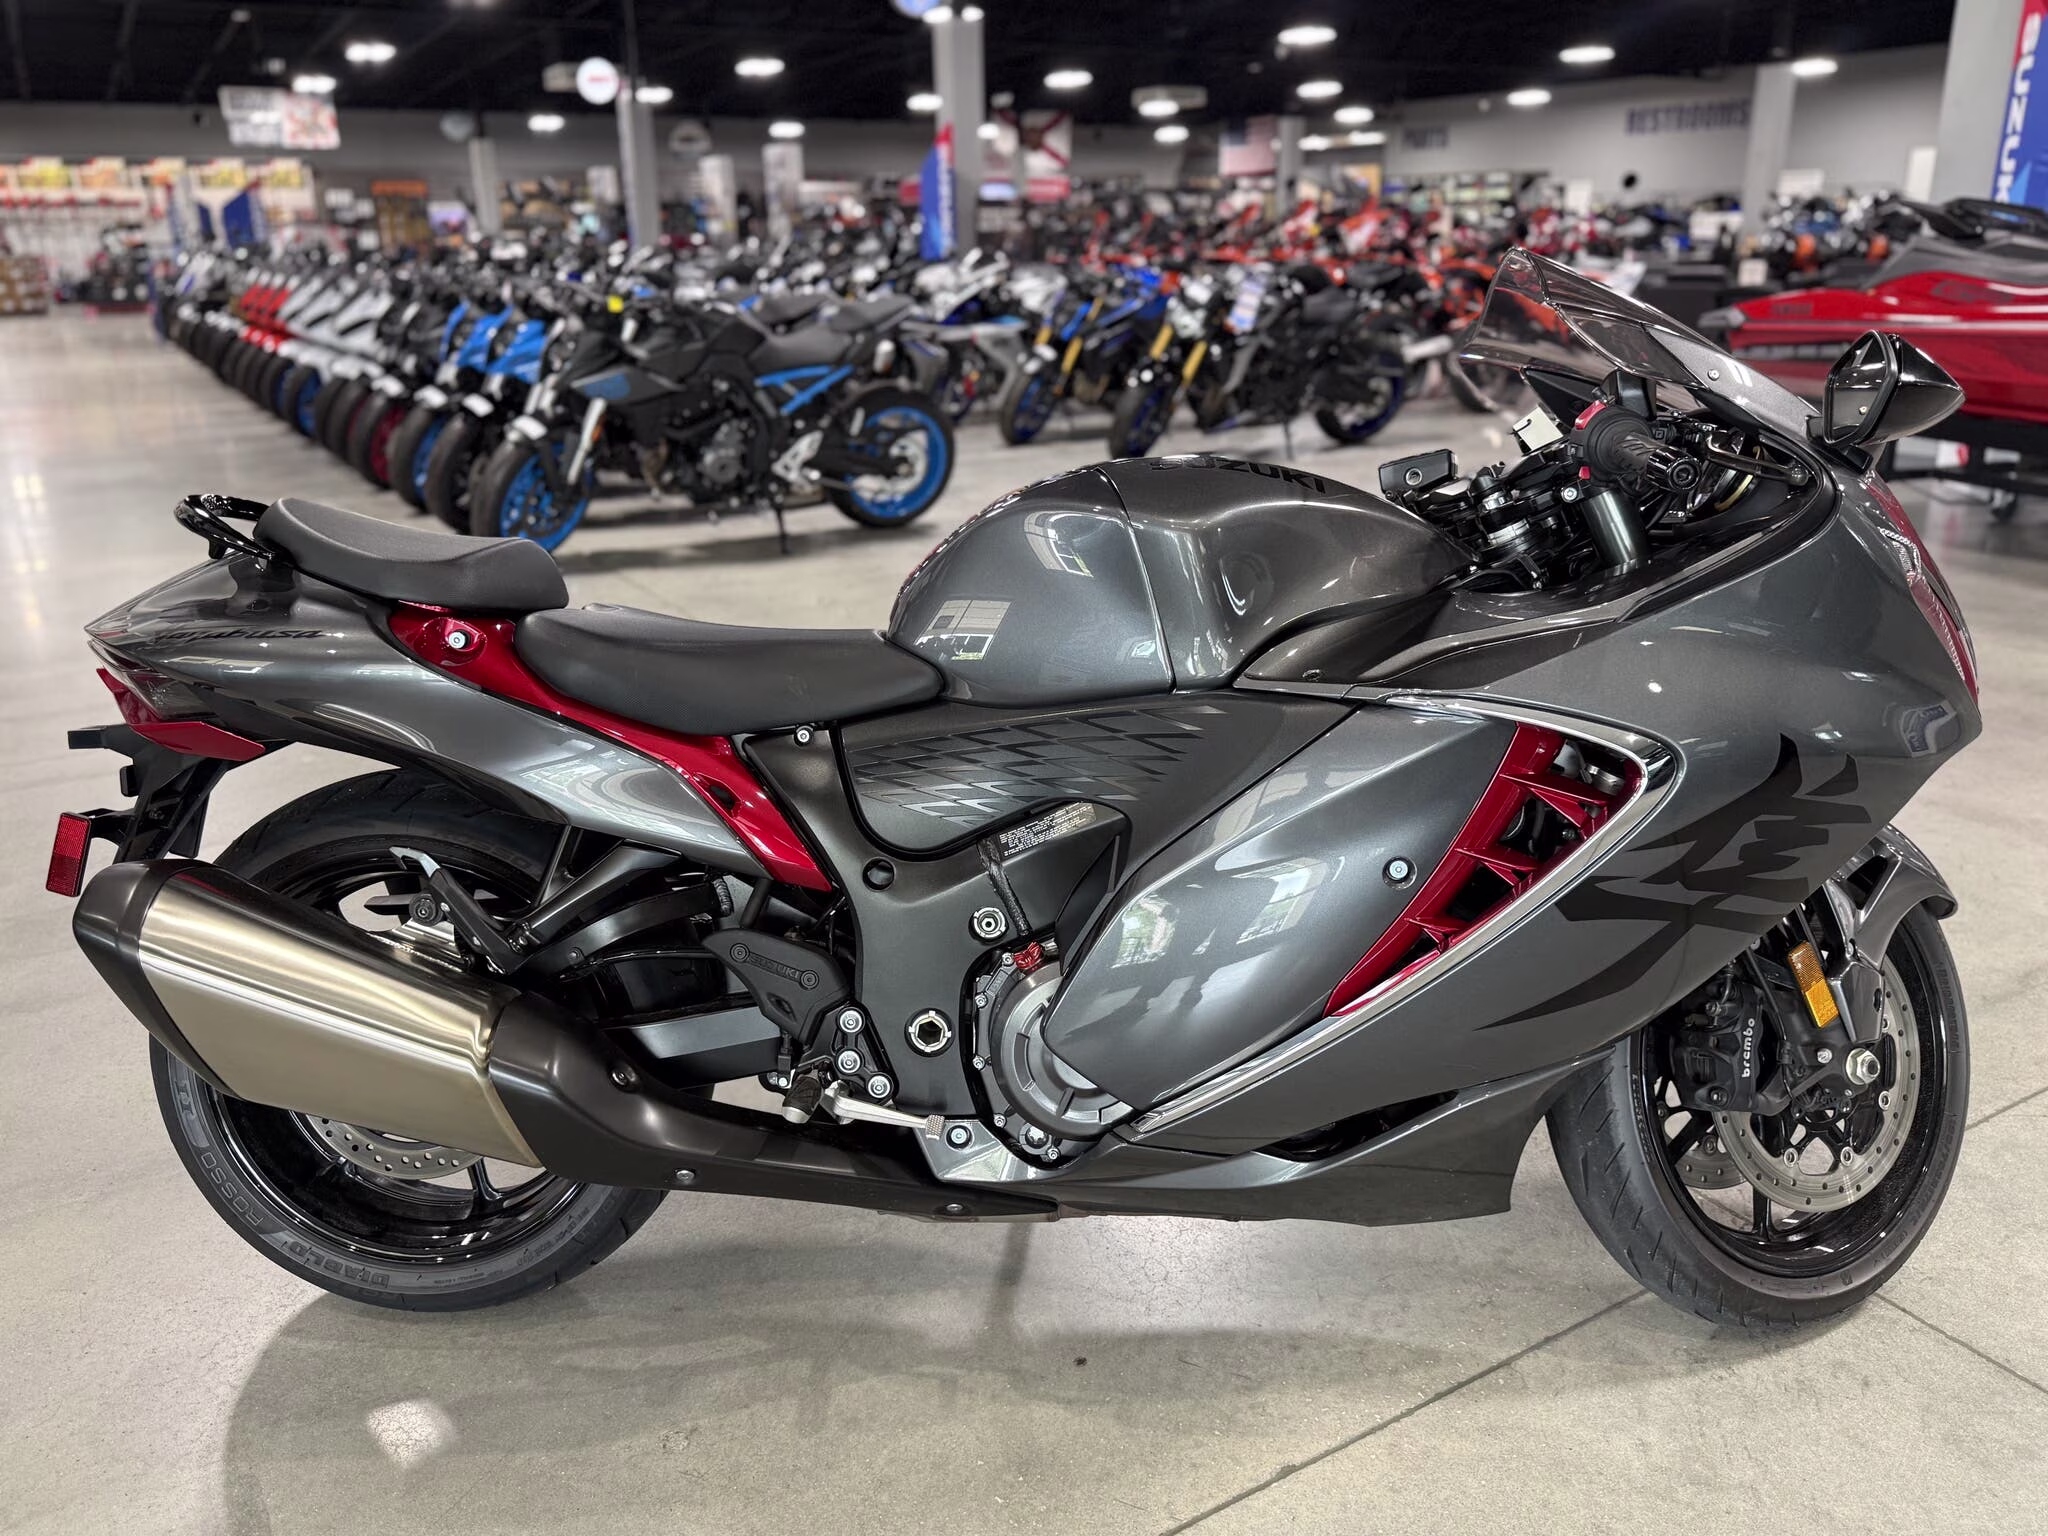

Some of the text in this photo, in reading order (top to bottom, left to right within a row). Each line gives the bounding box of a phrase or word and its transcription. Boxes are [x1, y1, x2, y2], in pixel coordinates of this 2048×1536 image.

[1150, 454, 1326, 494] SUZUKI
[1741, 1018, 1755, 1078] brembo
[200, 1151, 264, 1226] ROSSO
[289, 1239, 390, 1289] DIABLO
